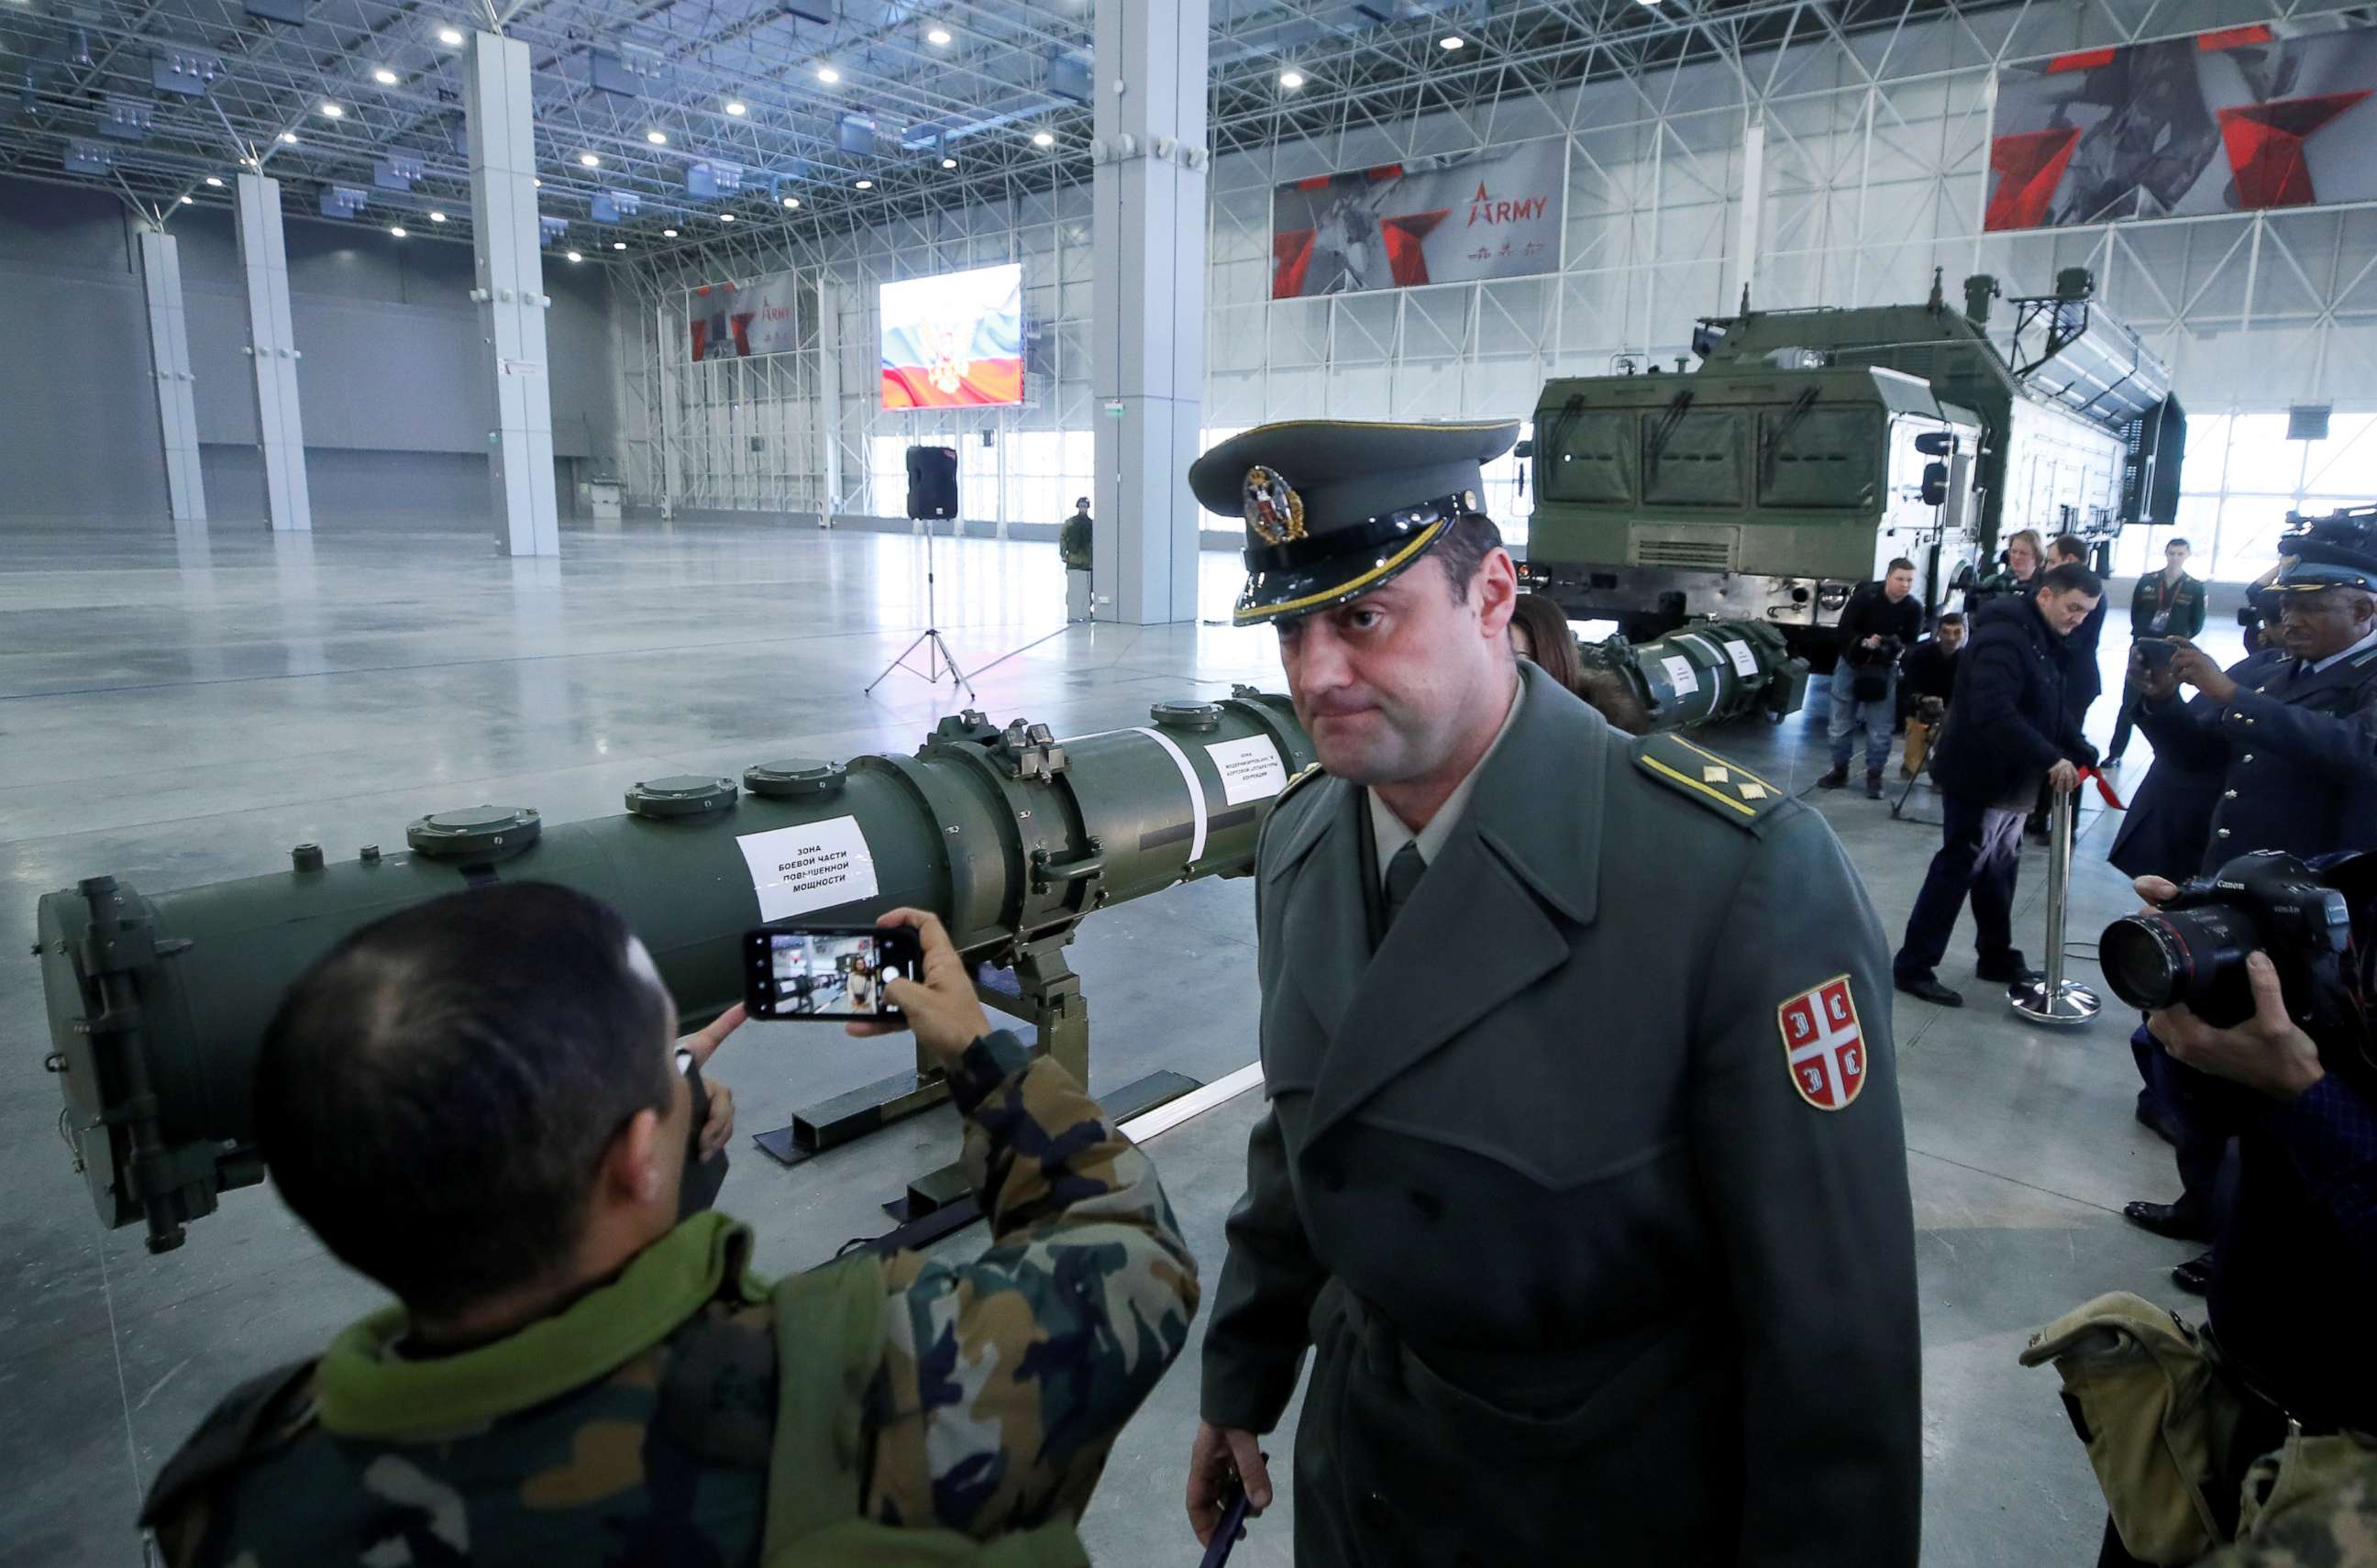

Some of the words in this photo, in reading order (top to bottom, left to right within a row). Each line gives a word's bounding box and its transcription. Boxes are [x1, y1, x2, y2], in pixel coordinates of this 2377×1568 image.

[1467, 179, 1547, 228] ARMY
[797, 845, 822, 856] ЗОНА
[779, 857, 815, 871] БОЕВОЙ
[818, 851, 846, 862] ЧАСТИ
[792, 874, 846, 892] МОЩНОСТИ
[2217, 879, 2245, 890] Canon
